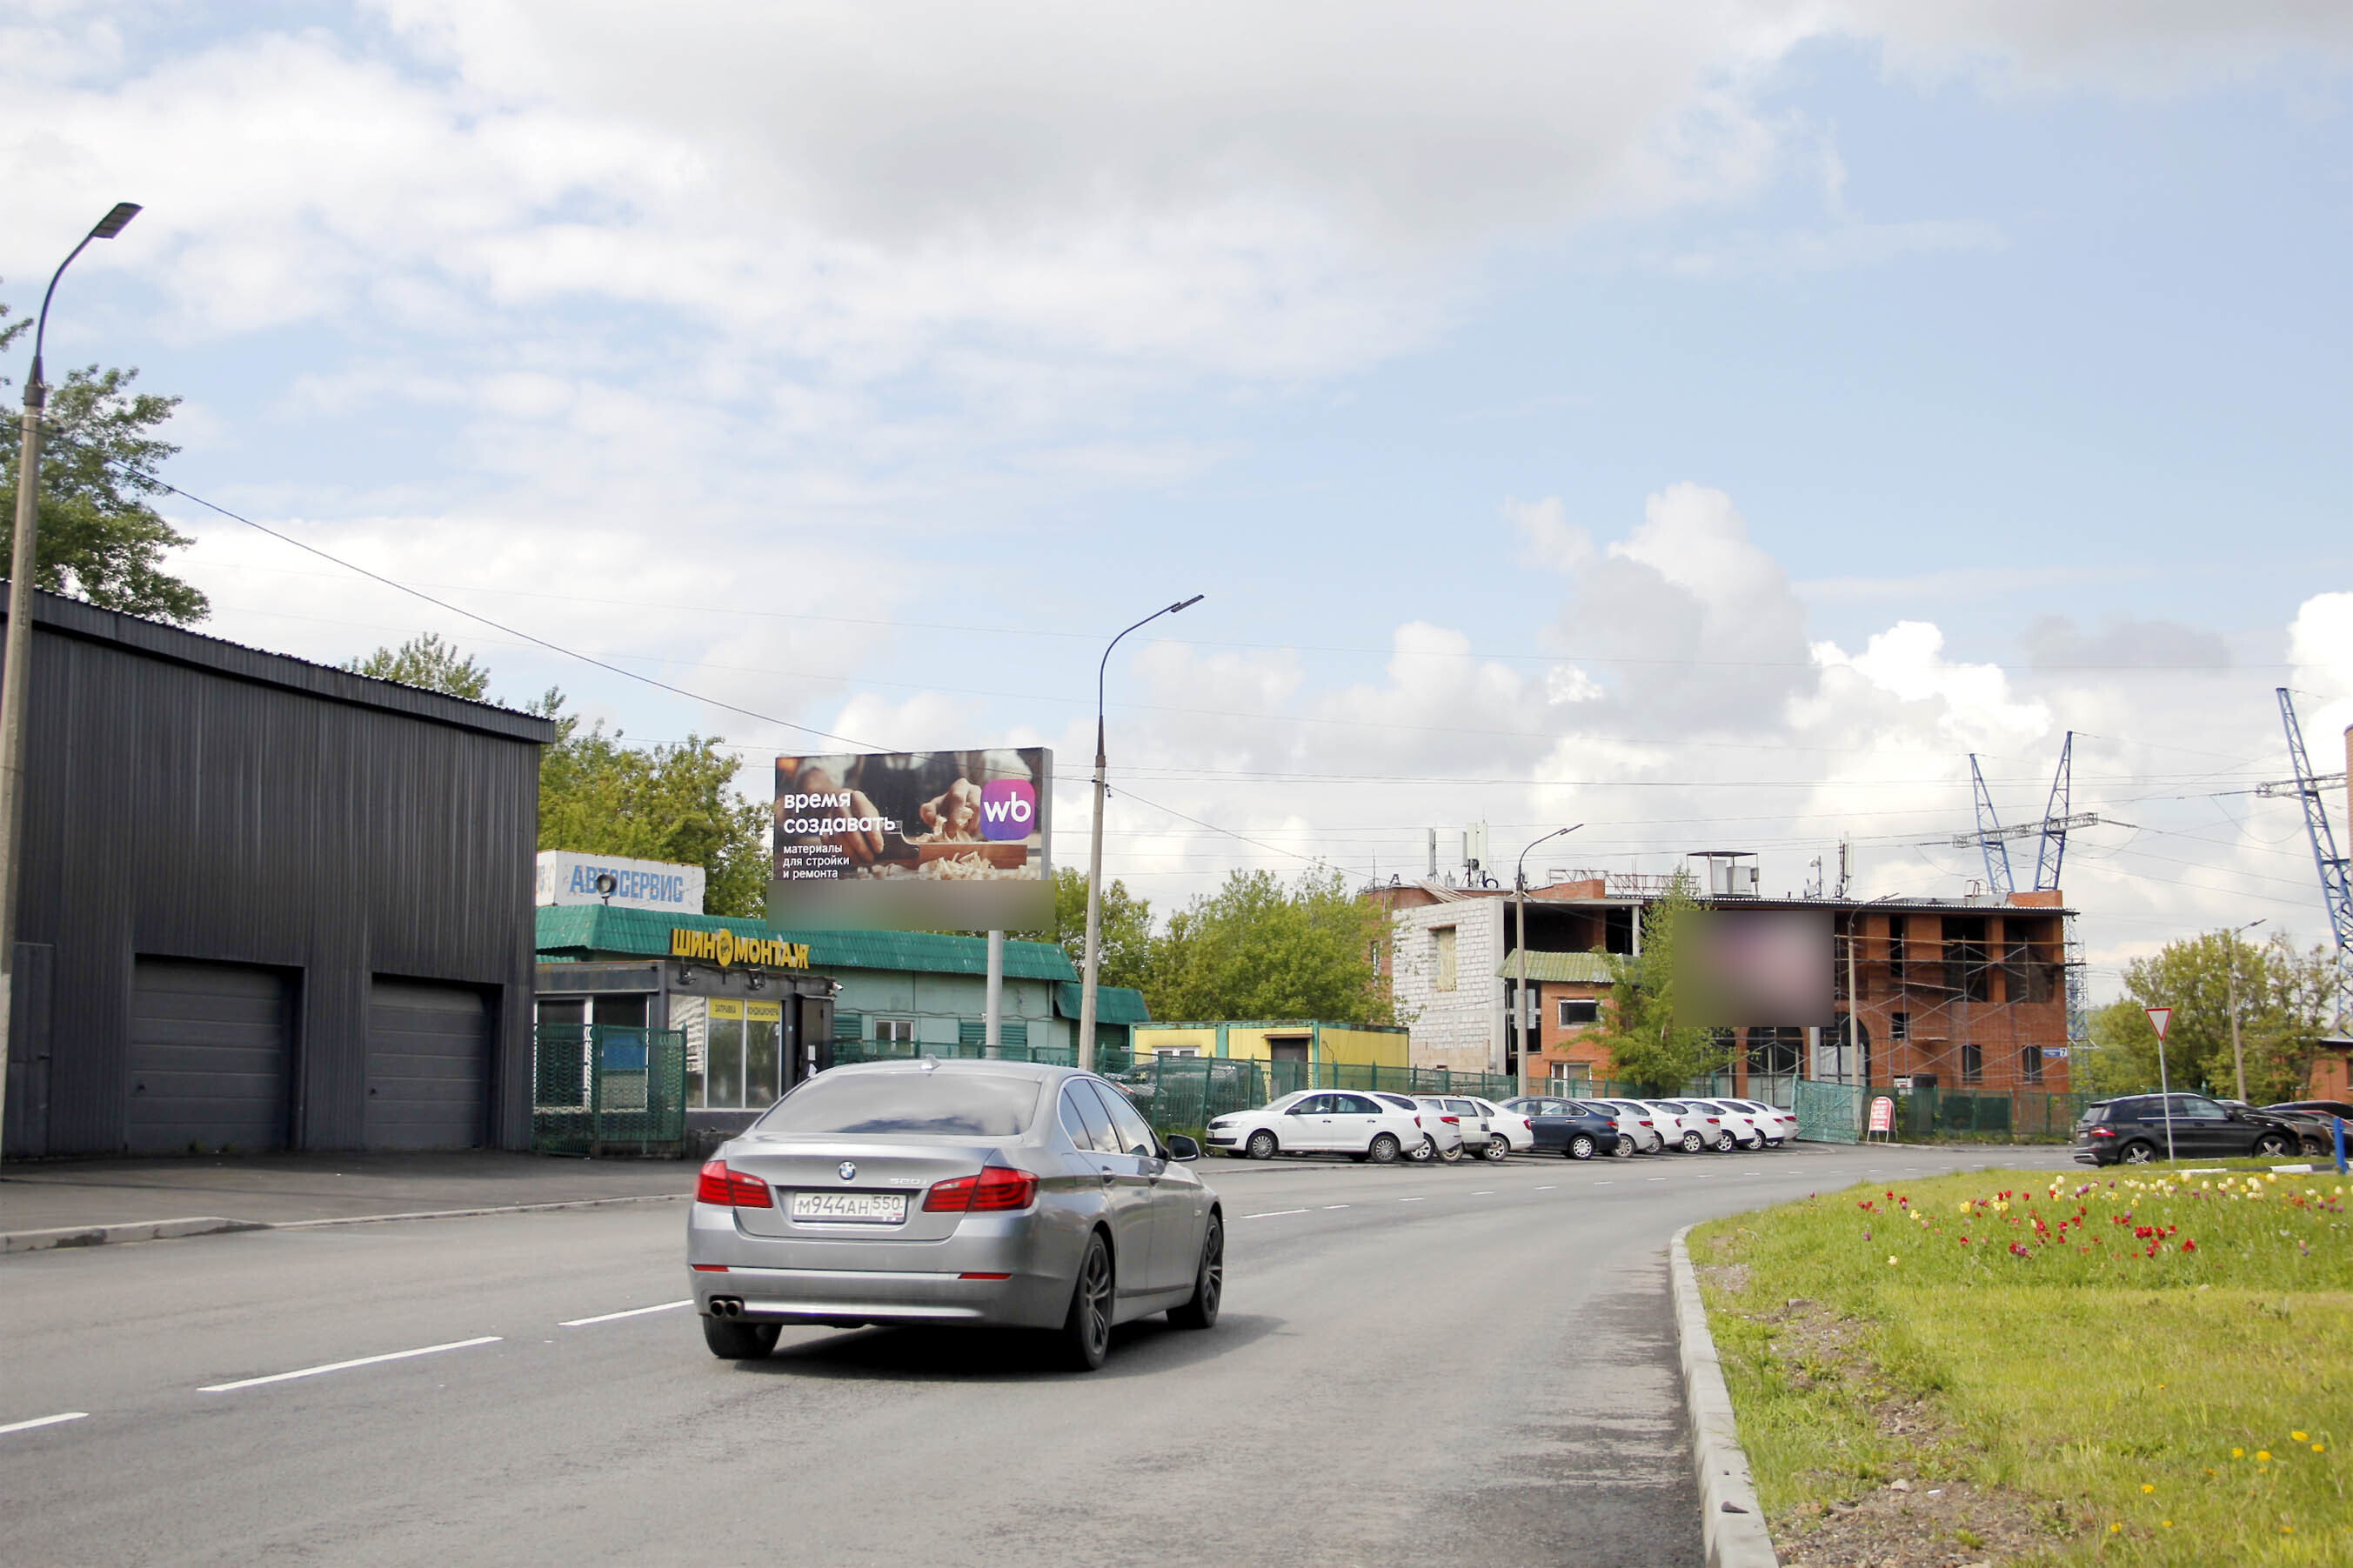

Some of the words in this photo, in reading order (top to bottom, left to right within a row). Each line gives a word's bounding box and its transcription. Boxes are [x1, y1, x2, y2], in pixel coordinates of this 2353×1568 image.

[784, 791, 851, 813] время
[984, 792, 1032, 823] wb
[784, 816, 896, 836] создавать
[784, 844, 843, 855] материалы
[783, 857, 803, 869] для
[806, 855, 850, 868] стройки
[783, 870, 790, 878] и
[792, 869, 839, 880] ремонта
[672, 928, 810, 969] ШИНОМОНТАЖ
[872, 1196, 900, 1210] 550
